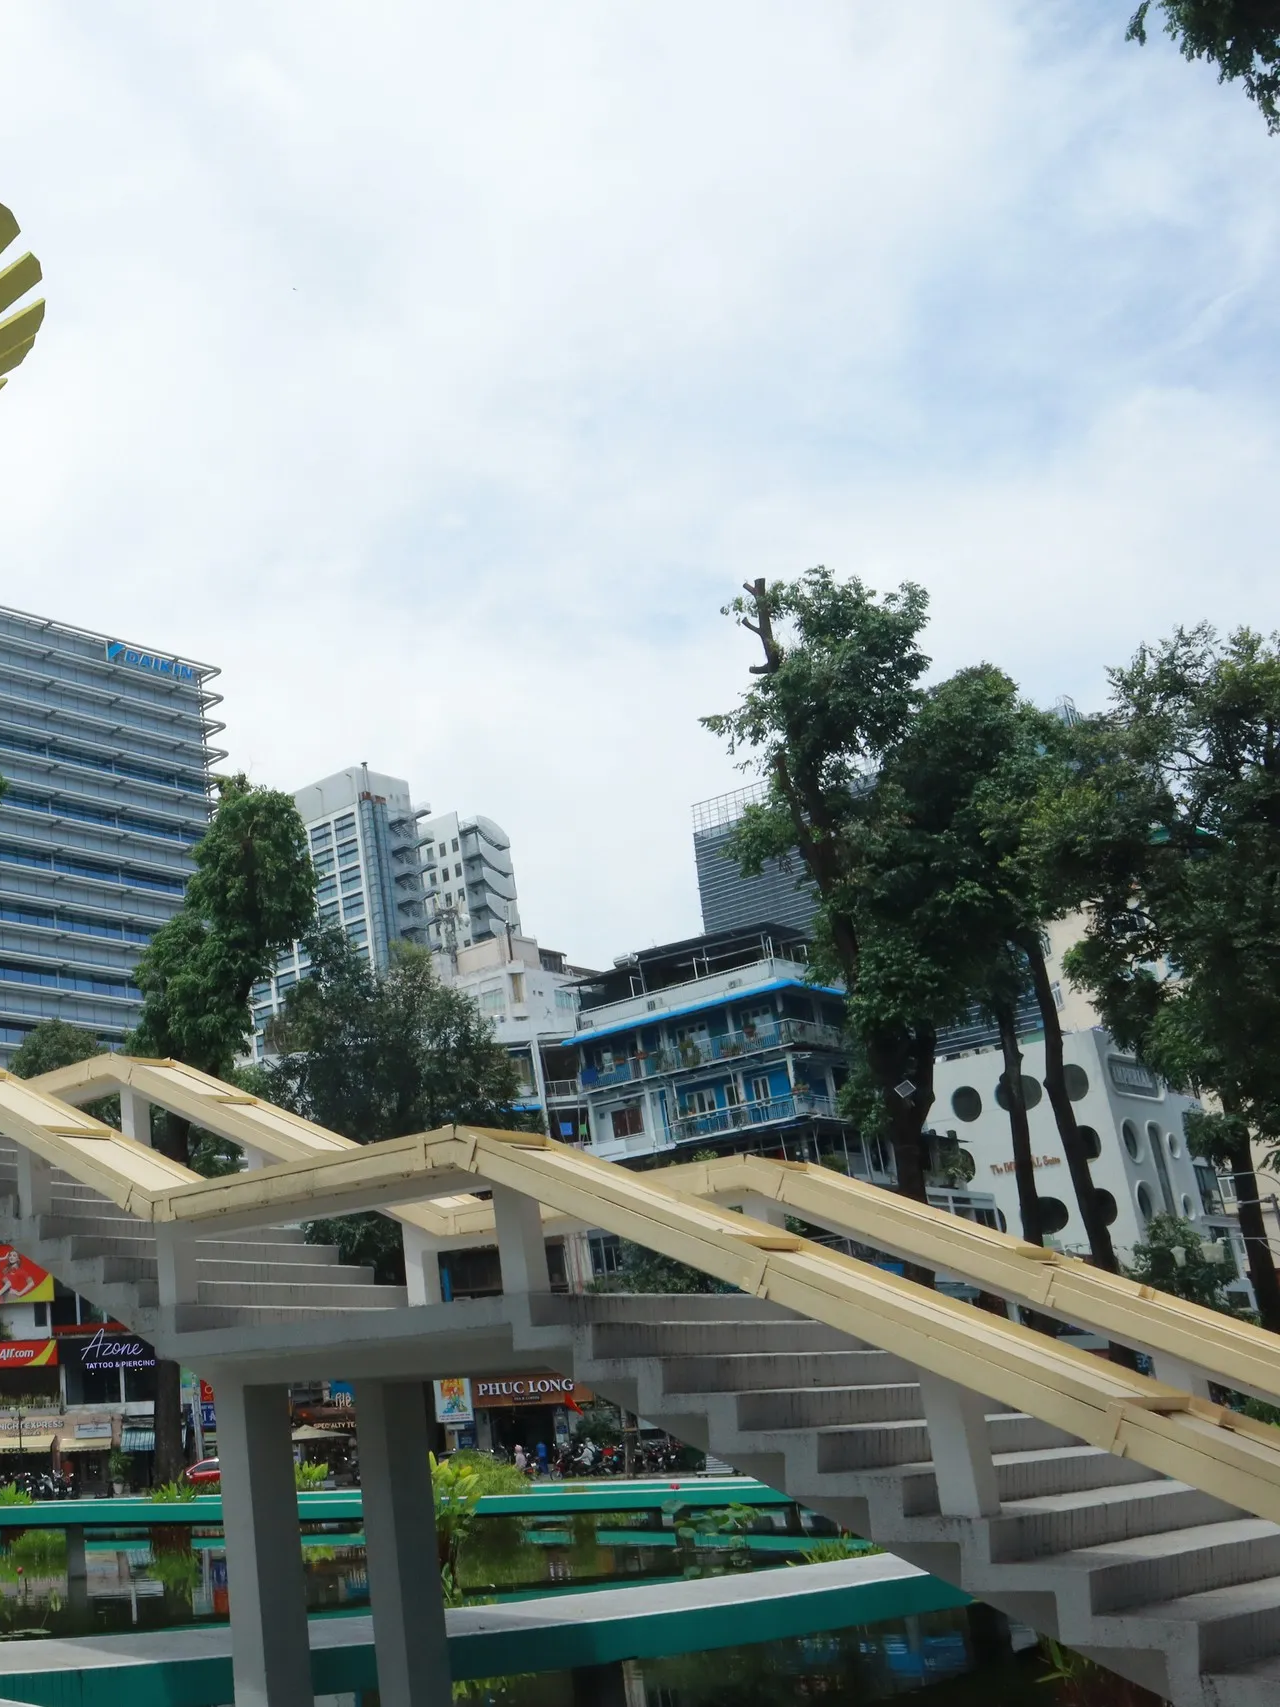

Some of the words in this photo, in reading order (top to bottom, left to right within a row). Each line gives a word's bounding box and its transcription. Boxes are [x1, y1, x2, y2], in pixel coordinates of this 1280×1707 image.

[124, 648, 193, 679] DAIKIN
[81, 1328, 144, 1360] Azone
[86, 1361, 114, 1369] TATTOO
[121, 1359, 156, 1368] PIERCING
[477, 1382, 525, 1397] PHUC
[529, 1378, 574, 1393] LONG
[24, 1419, 65, 1430] EXPRESS
